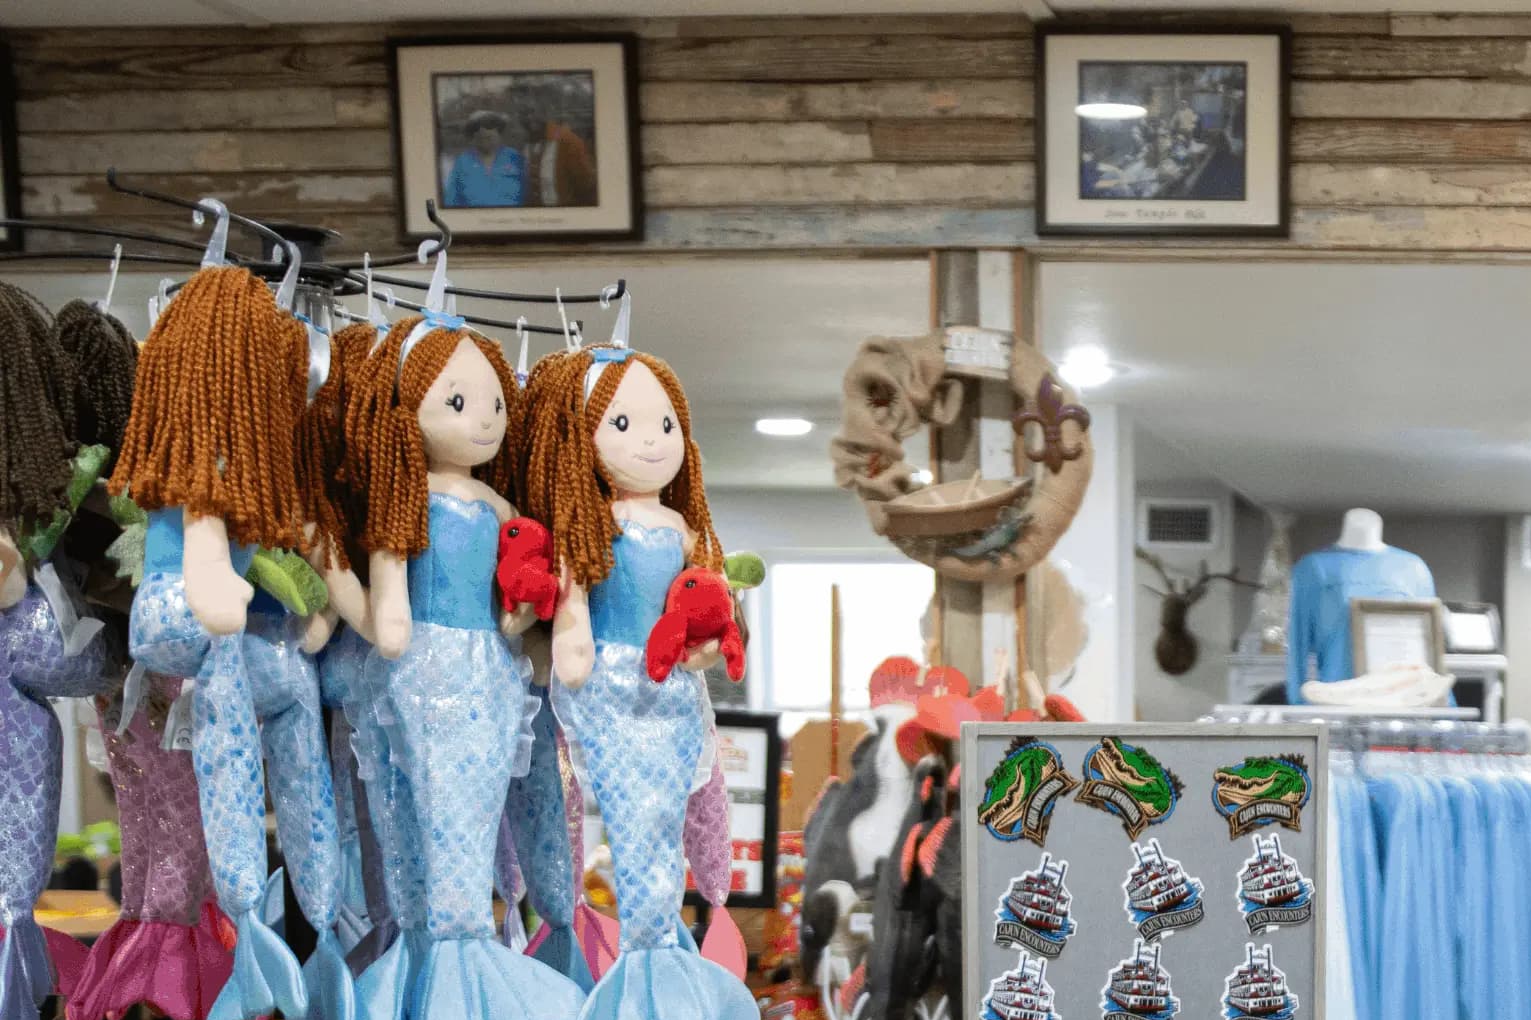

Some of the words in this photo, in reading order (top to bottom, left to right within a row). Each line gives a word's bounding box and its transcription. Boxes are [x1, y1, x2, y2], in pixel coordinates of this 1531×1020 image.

[1141, 917, 1162, 935] CAJUN
[1161, 906, 1202, 928] ENCOUNTERS
[1250, 910, 1268, 925] CAJUN
[1268, 908, 1311, 922] ENCOUNTERS
[1000, 924, 1019, 938] CAJUN
[1019, 927, 1061, 954] ENCOUNTERS
